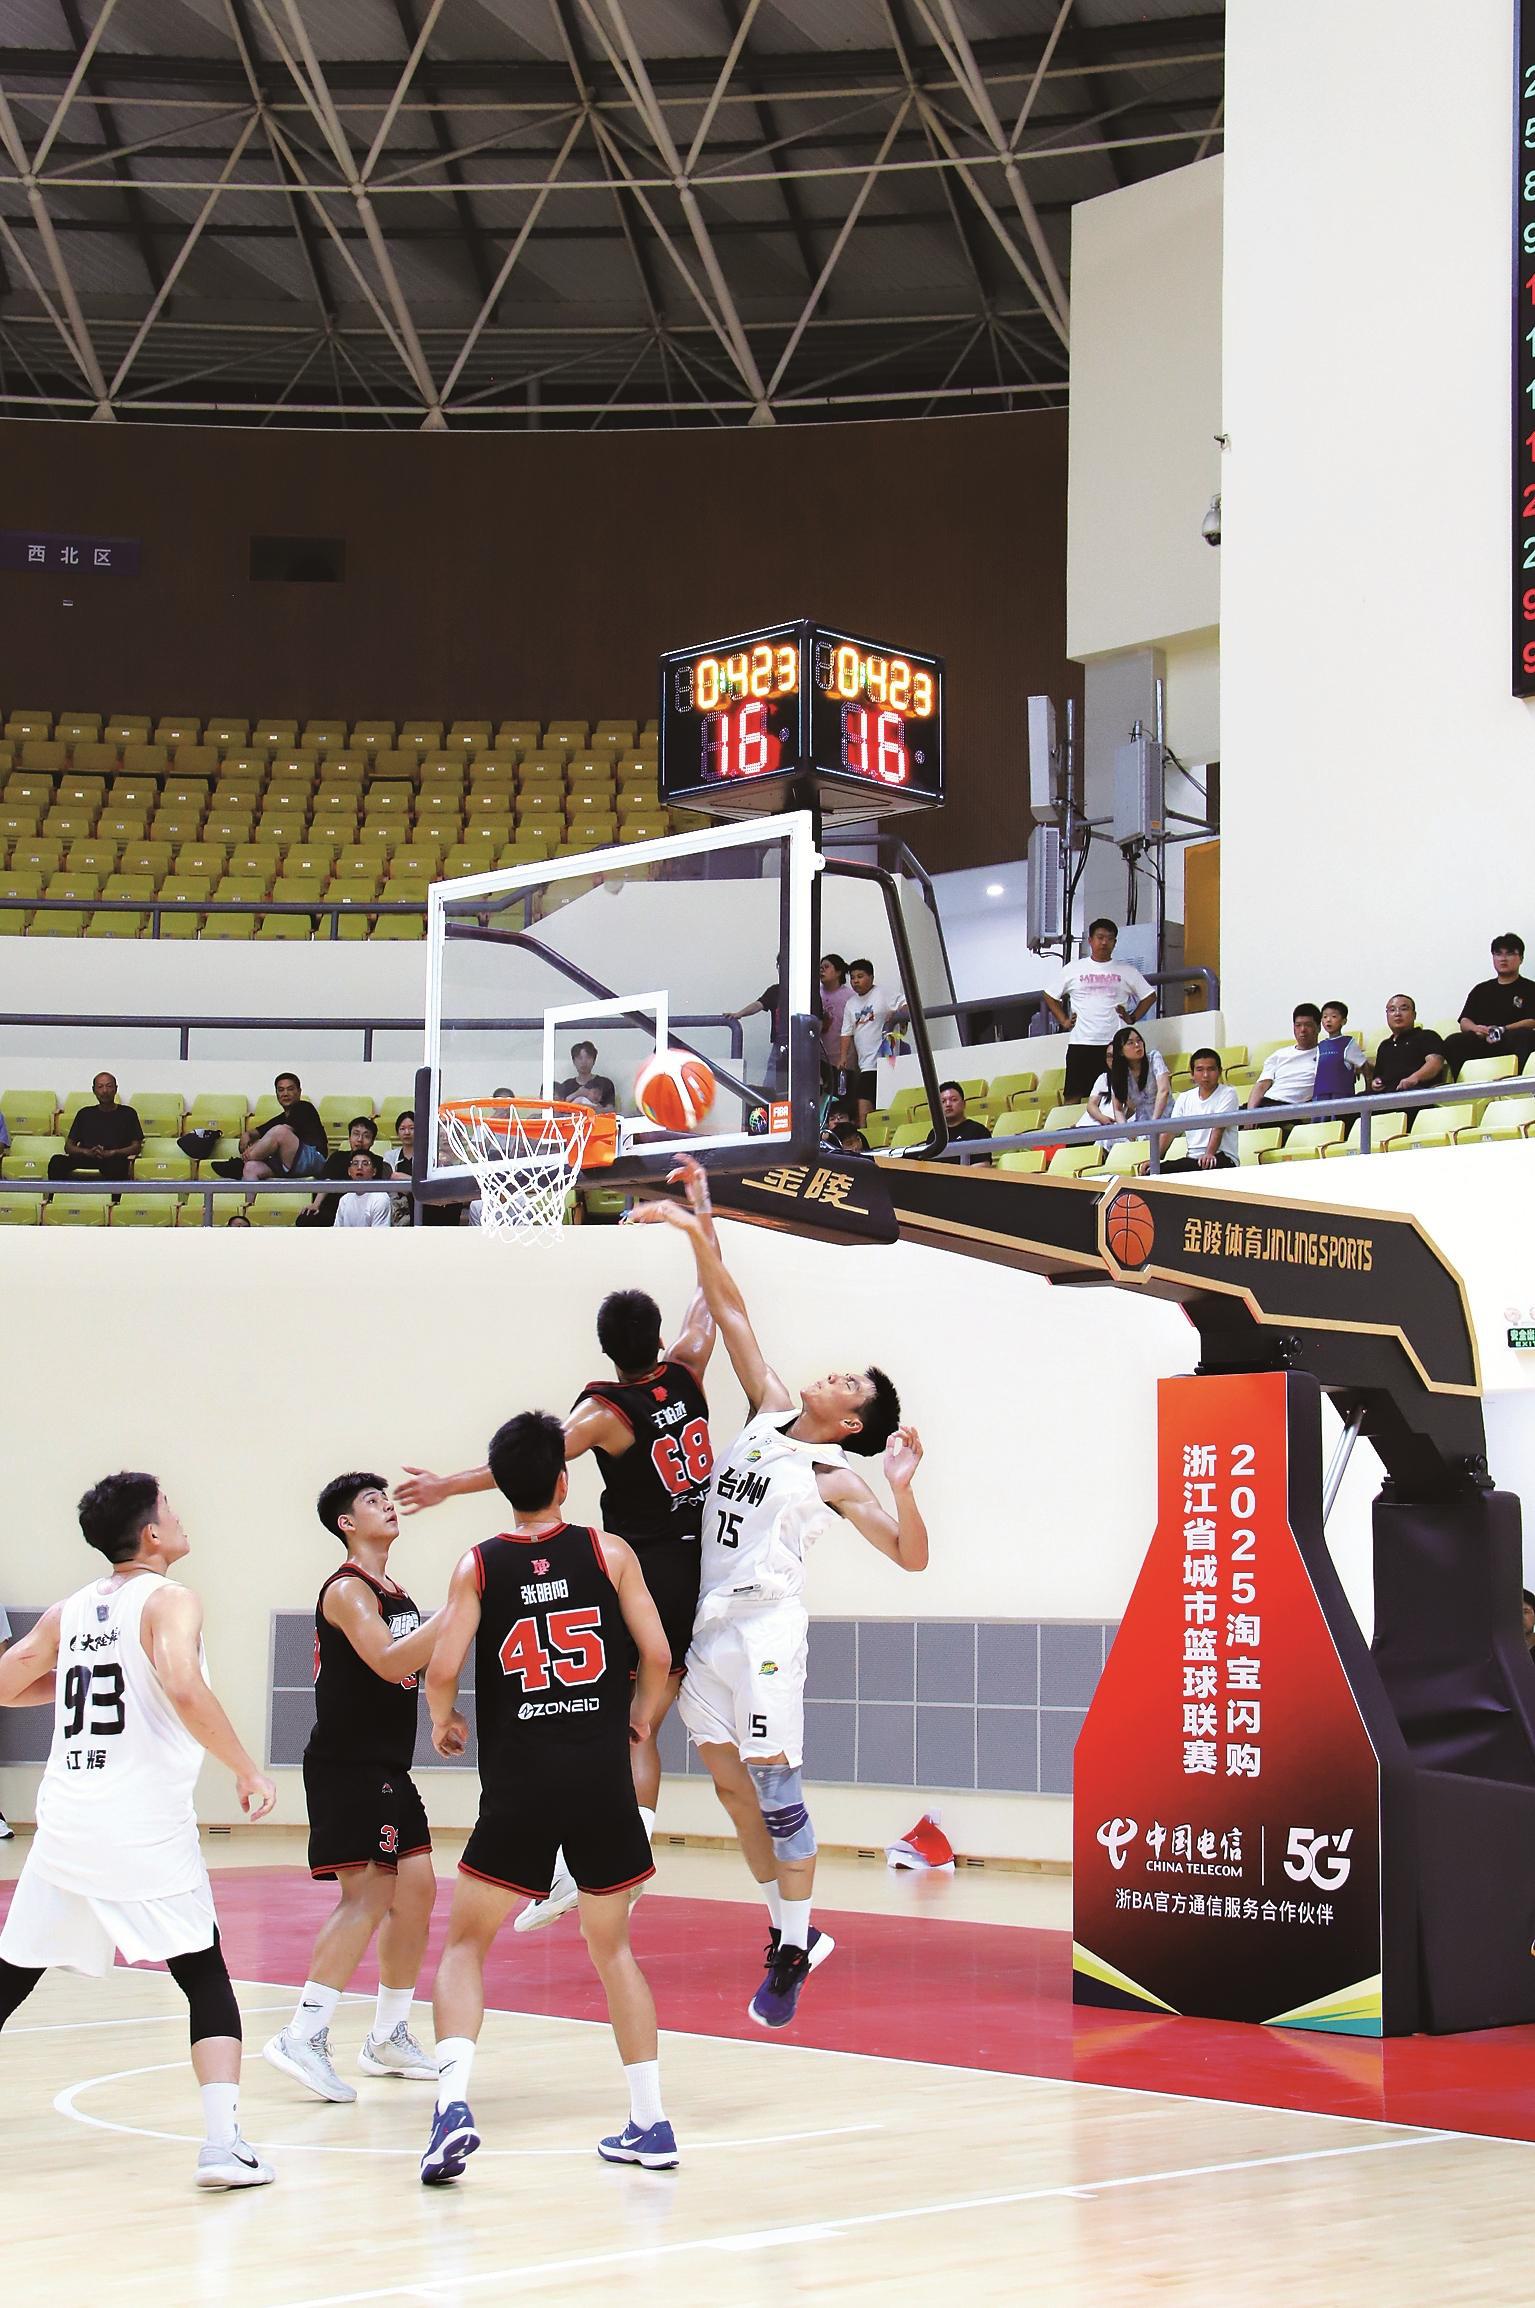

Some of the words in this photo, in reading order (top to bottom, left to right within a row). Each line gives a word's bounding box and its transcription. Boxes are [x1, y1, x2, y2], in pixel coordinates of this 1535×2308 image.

[28, 544, 112, 567] 西北区
[720, 701, 768, 775] 16
[859, 707, 906, 783] 16
[741, 1166, 870, 1216] 金陵
[1183, 1217, 1263, 1260] 金陵体育
[650, 1416, 715, 1497] 68
[716, 1465, 772, 1508] 台州
[716, 1509, 744, 1550] 15
[1182, 1443, 1218, 1776] 浙江省城市篮球联赛
[1226, 1443, 1262, 1779] 2025淘宝闪购
[498, 1605, 607, 1693] 45
[63, 1662, 126, 1740] 93
[379, 1824, 399, 1855] 3
[1145, 1820, 1243, 1862] 中国电信
[1283, 1826, 1354, 1891] 5G
[1145, 1860, 1183, 1873] CHINA
[1186, 1862, 1243, 1878] TELECOM
[1115, 1887, 1334, 1926] 浙BA官方通信服务合作伙伴
